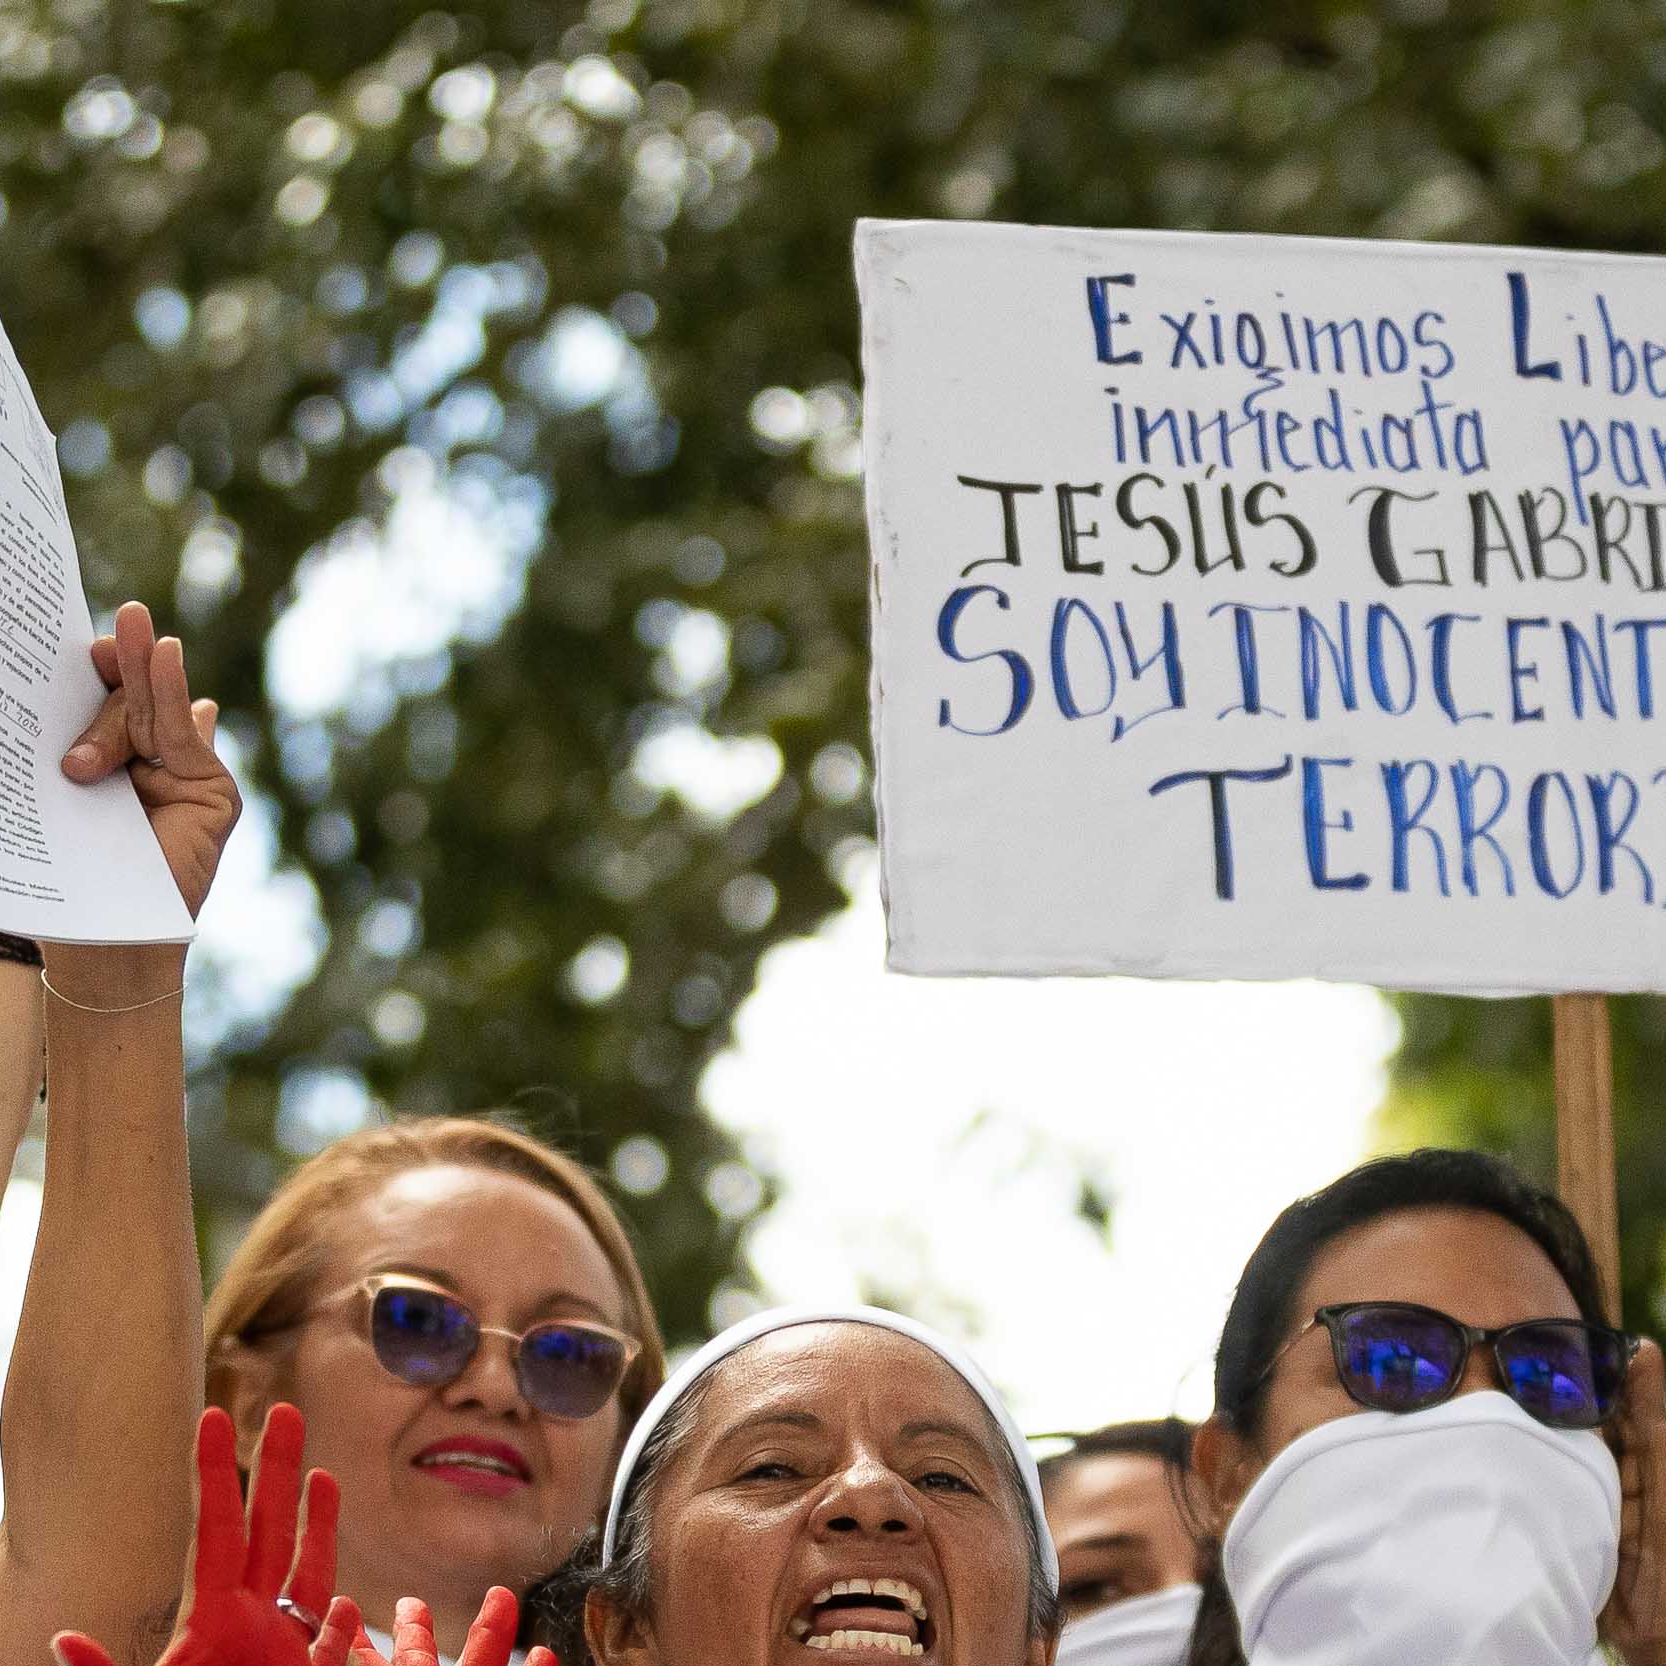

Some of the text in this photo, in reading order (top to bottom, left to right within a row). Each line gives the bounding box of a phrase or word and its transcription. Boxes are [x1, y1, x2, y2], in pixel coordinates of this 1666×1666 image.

[1086, 272, 1456, 412] Exigimos
[1109, 379, 1490, 476] inmediata
[937, 584, 1186, 743] SOY
